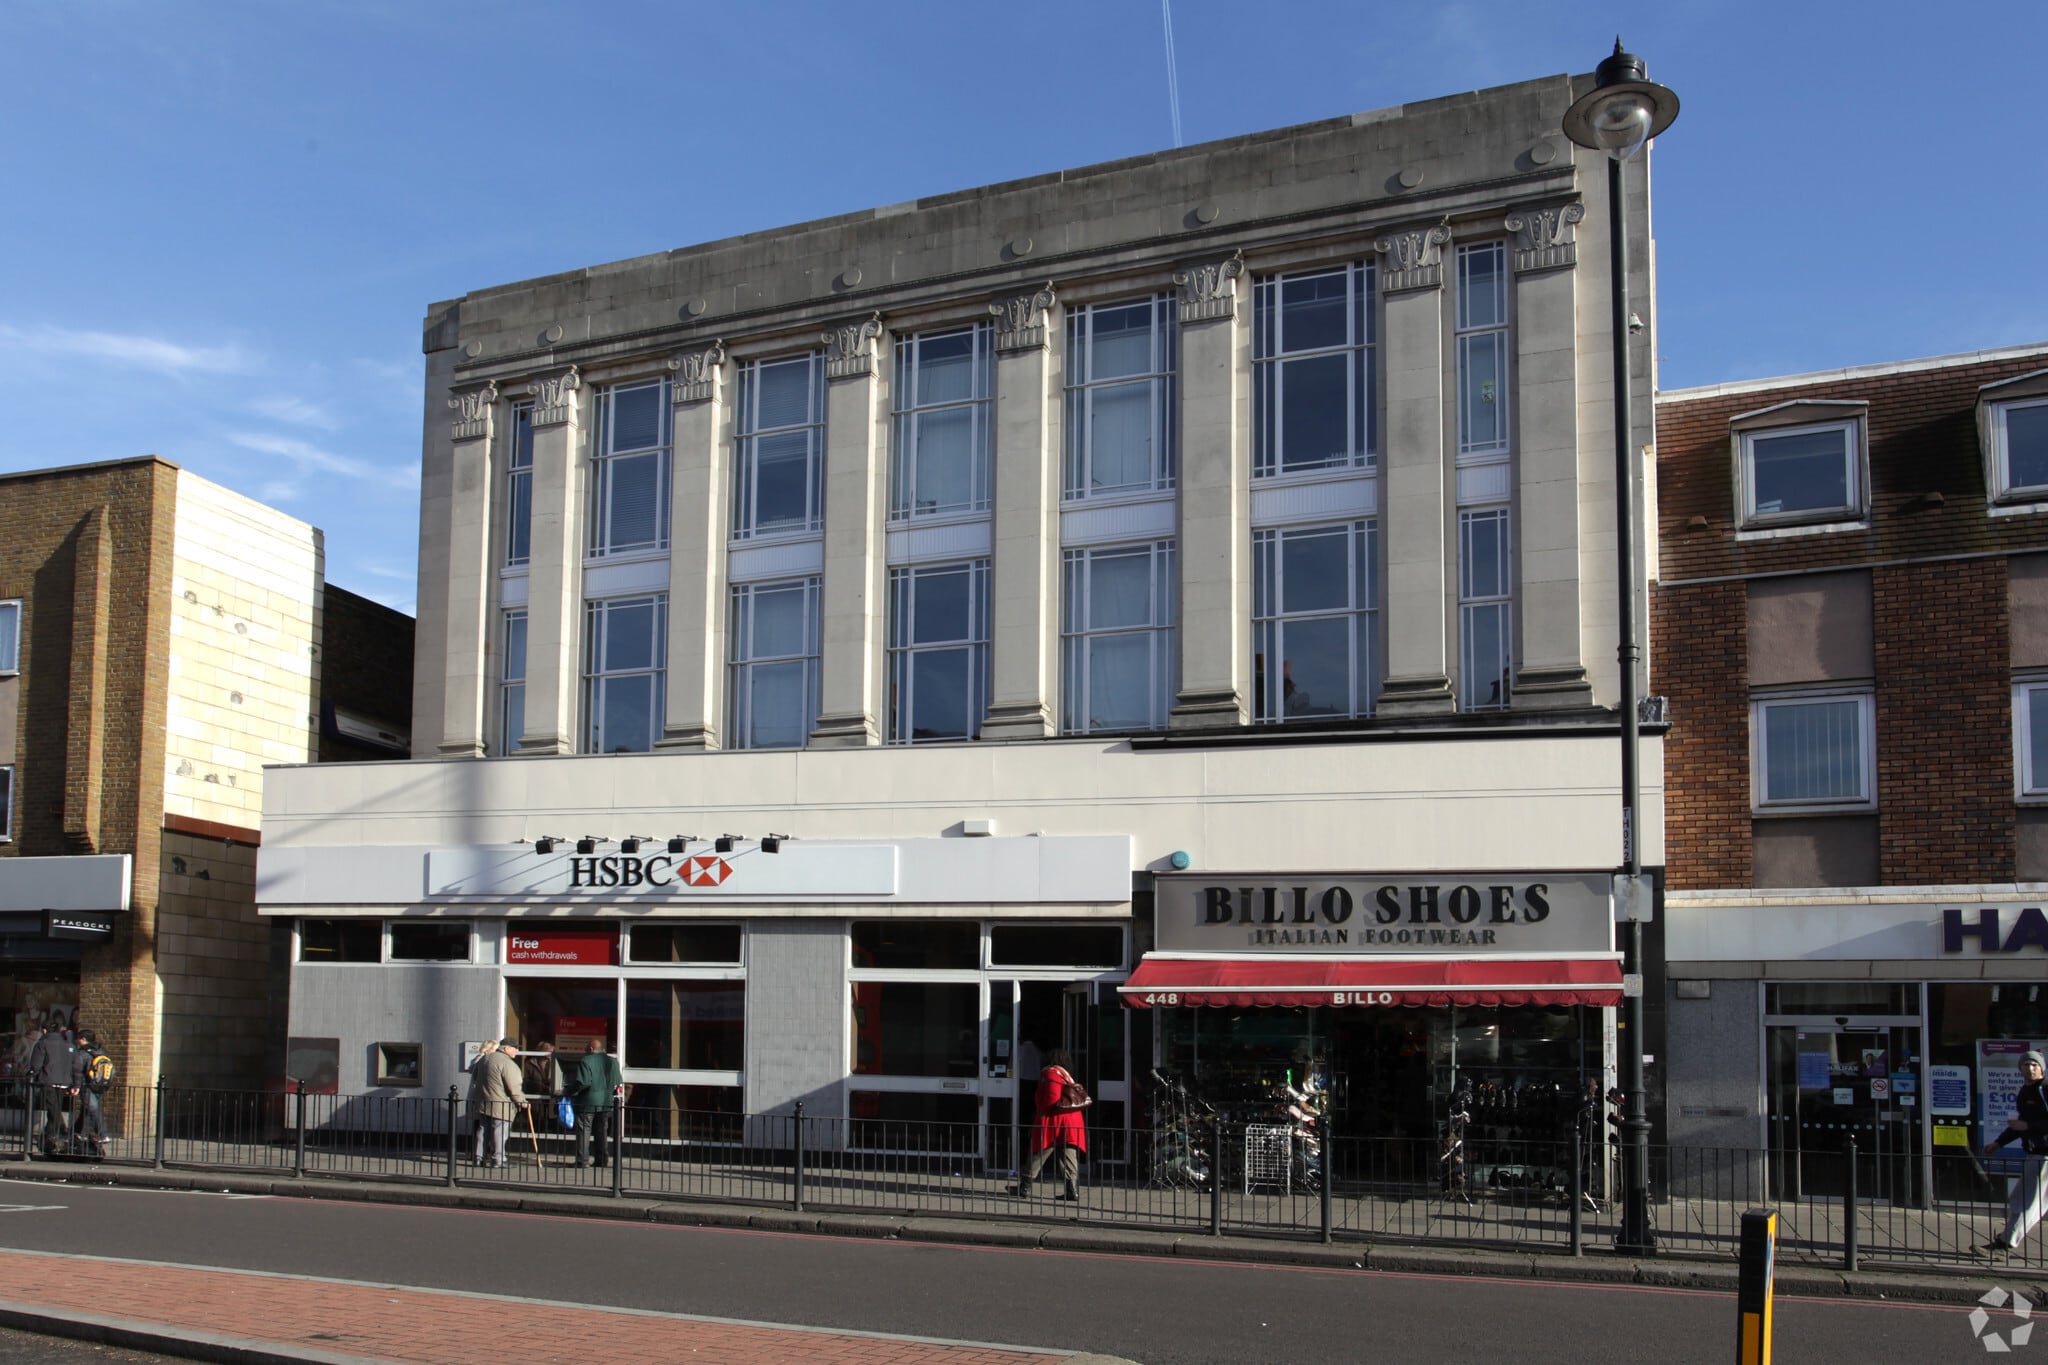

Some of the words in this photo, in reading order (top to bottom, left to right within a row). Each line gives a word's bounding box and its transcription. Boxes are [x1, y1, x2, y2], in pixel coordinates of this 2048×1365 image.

[569, 856, 673, 887] HSBC
[1375, 883, 1550, 924] SHOES
[52, 918, 111, 930] PEACOCKS
[1256, 929, 1348, 944] ITALIAN
[1365, 929, 1497, 944] FOOTWEAR
[511, 937, 540, 949] Free
[511, 951, 530, 959] cash
[531, 950, 578, 960] withdrawals
[1145, 993, 1178, 1005] 448
[1333, 992, 1393, 1005] BILLO
[559, 1018, 577, 1028] Free
